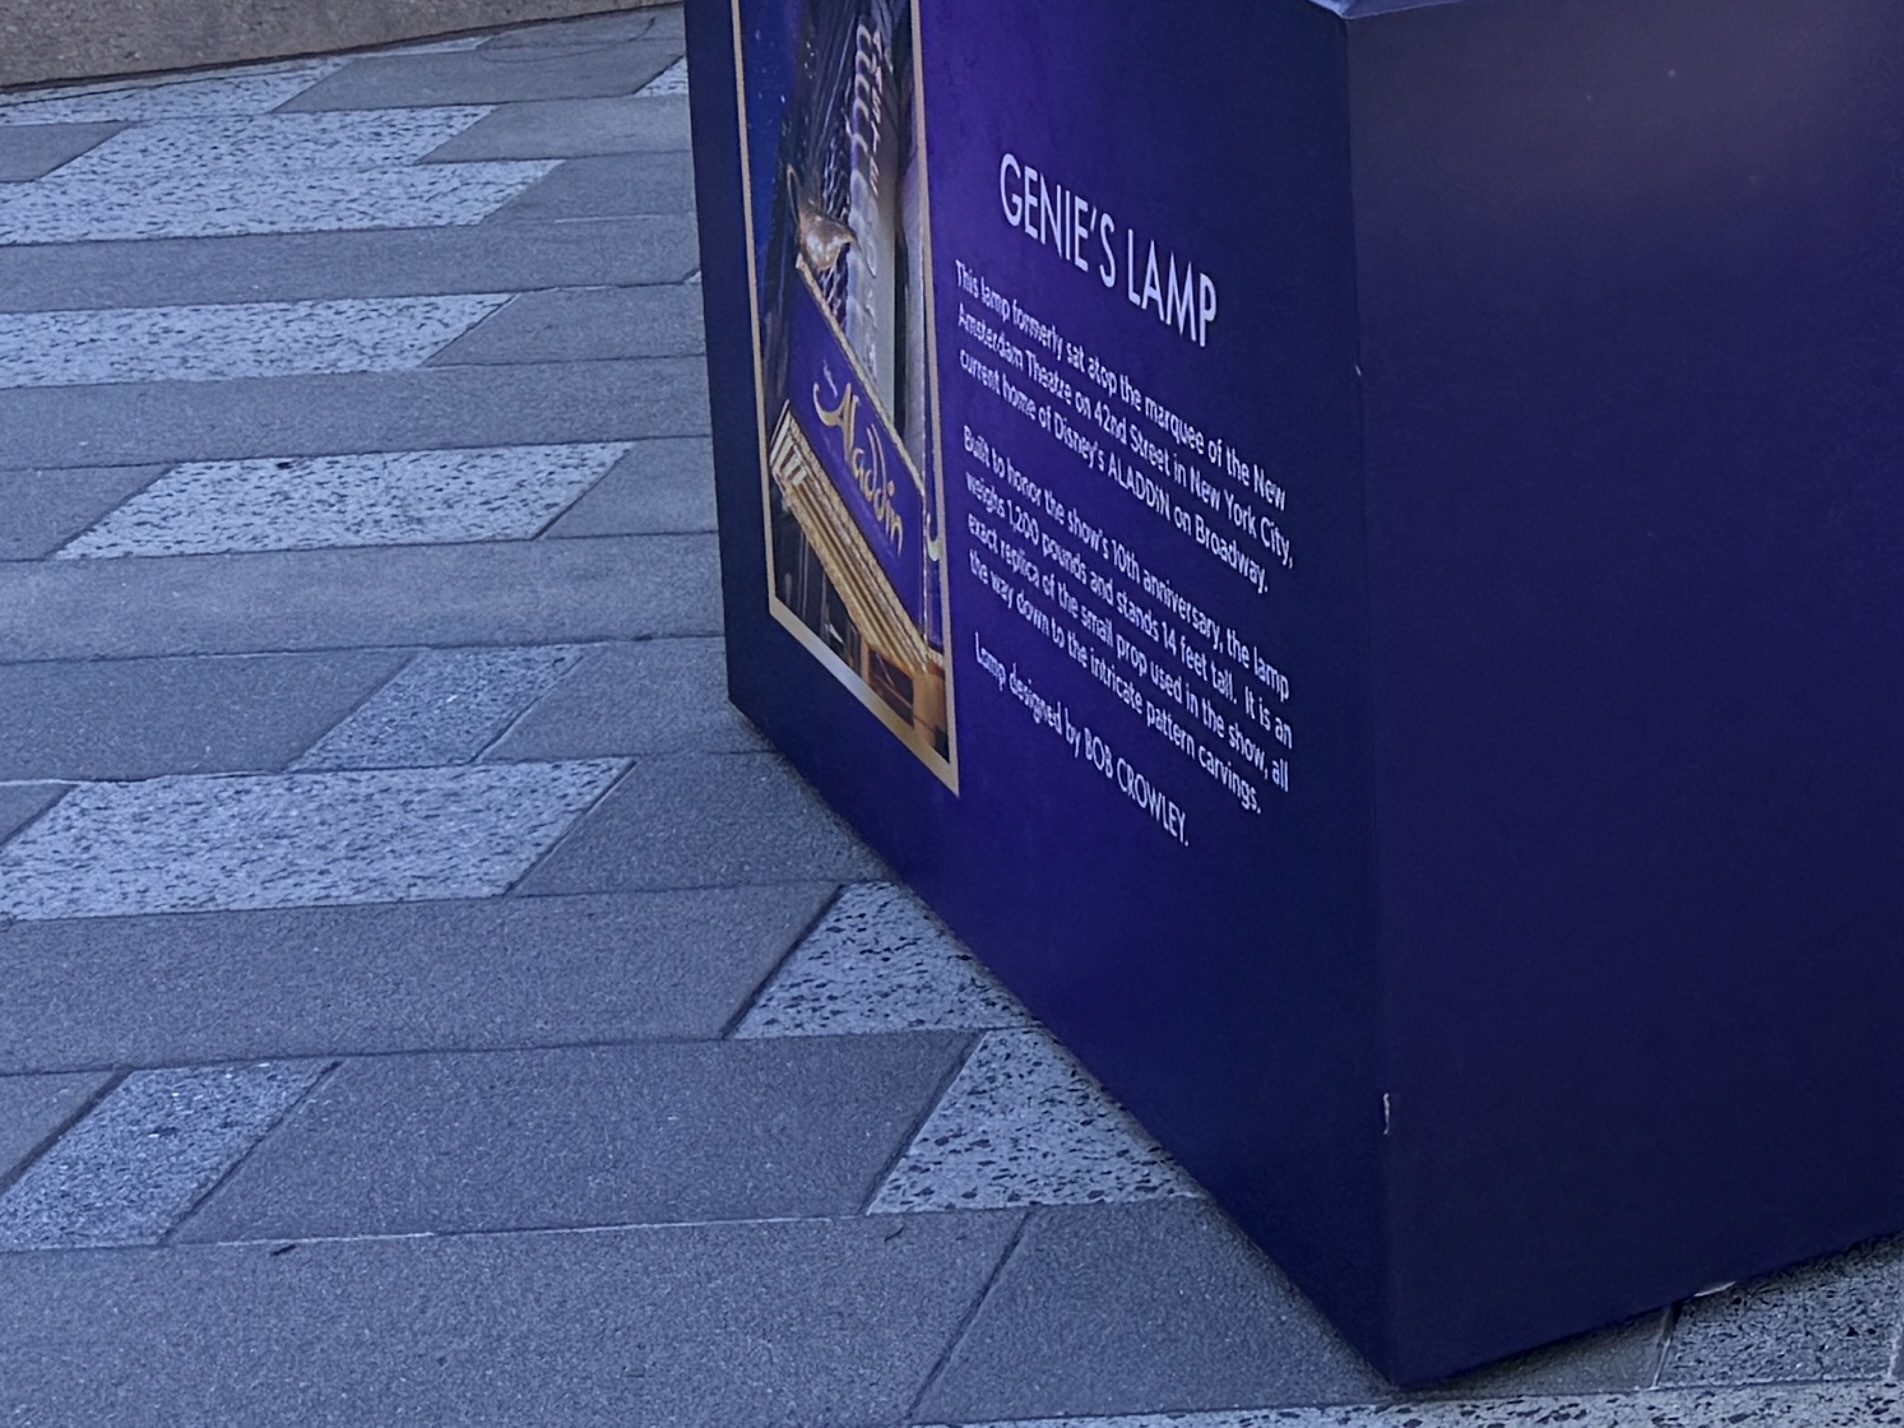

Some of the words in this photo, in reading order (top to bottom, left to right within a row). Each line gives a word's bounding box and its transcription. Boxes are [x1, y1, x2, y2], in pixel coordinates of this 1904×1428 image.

[1001, 154, 1115, 287] GENIE'S
[1128, 229, 1216, 347] LAMP
[813, 382, 904, 555] Aladdin
[955, 259, 980, 299] This
[980, 276, 1011, 323] lamp
[1011, 298, 1064, 362] formerly
[1066, 342, 1086, 373] sat
[1087, 356, 1118, 398] atop
[1119, 374, 1142, 412] the
[1144, 396, 1205, 455] marquee
[1207, 438, 1223, 468] of
[1225, 446, 1250, 487] the
[1253, 463, 1286, 511] New
[959, 348, 1001, 396] current
[1002, 373, 1037, 421] home
[1038, 405, 1052, 432] of
[1053, 411, 1105, 472] Disney's
[1173, 505, 1192, 536] on
[1194, 513, 1269, 594] Broadway.
[1024, 349, 1073, 406] Theatre
[1074, 391, 1092, 420] on
[1093, 400, 1128, 445] 42nd
[1129, 423, 1171, 477] Street
[1173, 452, 1187, 488] in
[1189, 465, 1221, 512] New
[1223, 489, 1257, 539] York
[1260, 516, 1293, 569] City,
[963, 424, 991, 468] Built
[991, 447, 1006, 479] to
[1006, 457, 1042, 507] honor
[1043, 488, 1065, 526] the
[1067, 507, 1109, 560] show's
[1111, 539, 1141, 584] 10th
[1142, 569, 1224, 654] anniversary,
[1226, 627, 1250, 669] the
[1253, 646, 1290, 703] lamp
[967, 513, 999, 555] exact
[1000, 539, 1040, 589] replica
[1041, 573, 1056, 600] of
[1057, 581, 1079, 619] the
[1080, 605, 1114, 648] small
[1115, 633, 1148, 678] prop
[1150, 661, 1183, 705] used
[1185, 682, 1199, 719] in
[1201, 697, 1225, 739] the
[1228, 722, 1269, 780] show,
[1271, 758, 1289, 793] all
[1041, 532, 1087, 585] pounds
[1089, 570, 1114, 606] and
[1116, 591, 1160, 643] stands
[1161, 620, 1177, 657] 14
[1179, 635, 1208, 682] feet
[1210, 660, 1238, 705] tall.
[1244, 685, 1256, 720] It
[1258, 696, 1271, 732] is
[1274, 716, 1293, 750] an
[969, 548, 989, 585] the
[989, 570, 1015, 609] way
[1015, 589, 1050, 637] down
[1051, 617, 1066, 649] to
[1066, 630, 1089, 669] the
[1089, 647, 1143, 715] intricate
[1146, 700, 1196, 759] pattern
[1198, 745, 1262, 815] carvings.
[974, 631, 1007, 692] Lamp
[1008, 662, 1063, 735] designed
[1064, 707, 1082, 758] by
[1083, 727, 1114, 779] BOB
[1116, 757, 1189, 847] CROWLEY.
